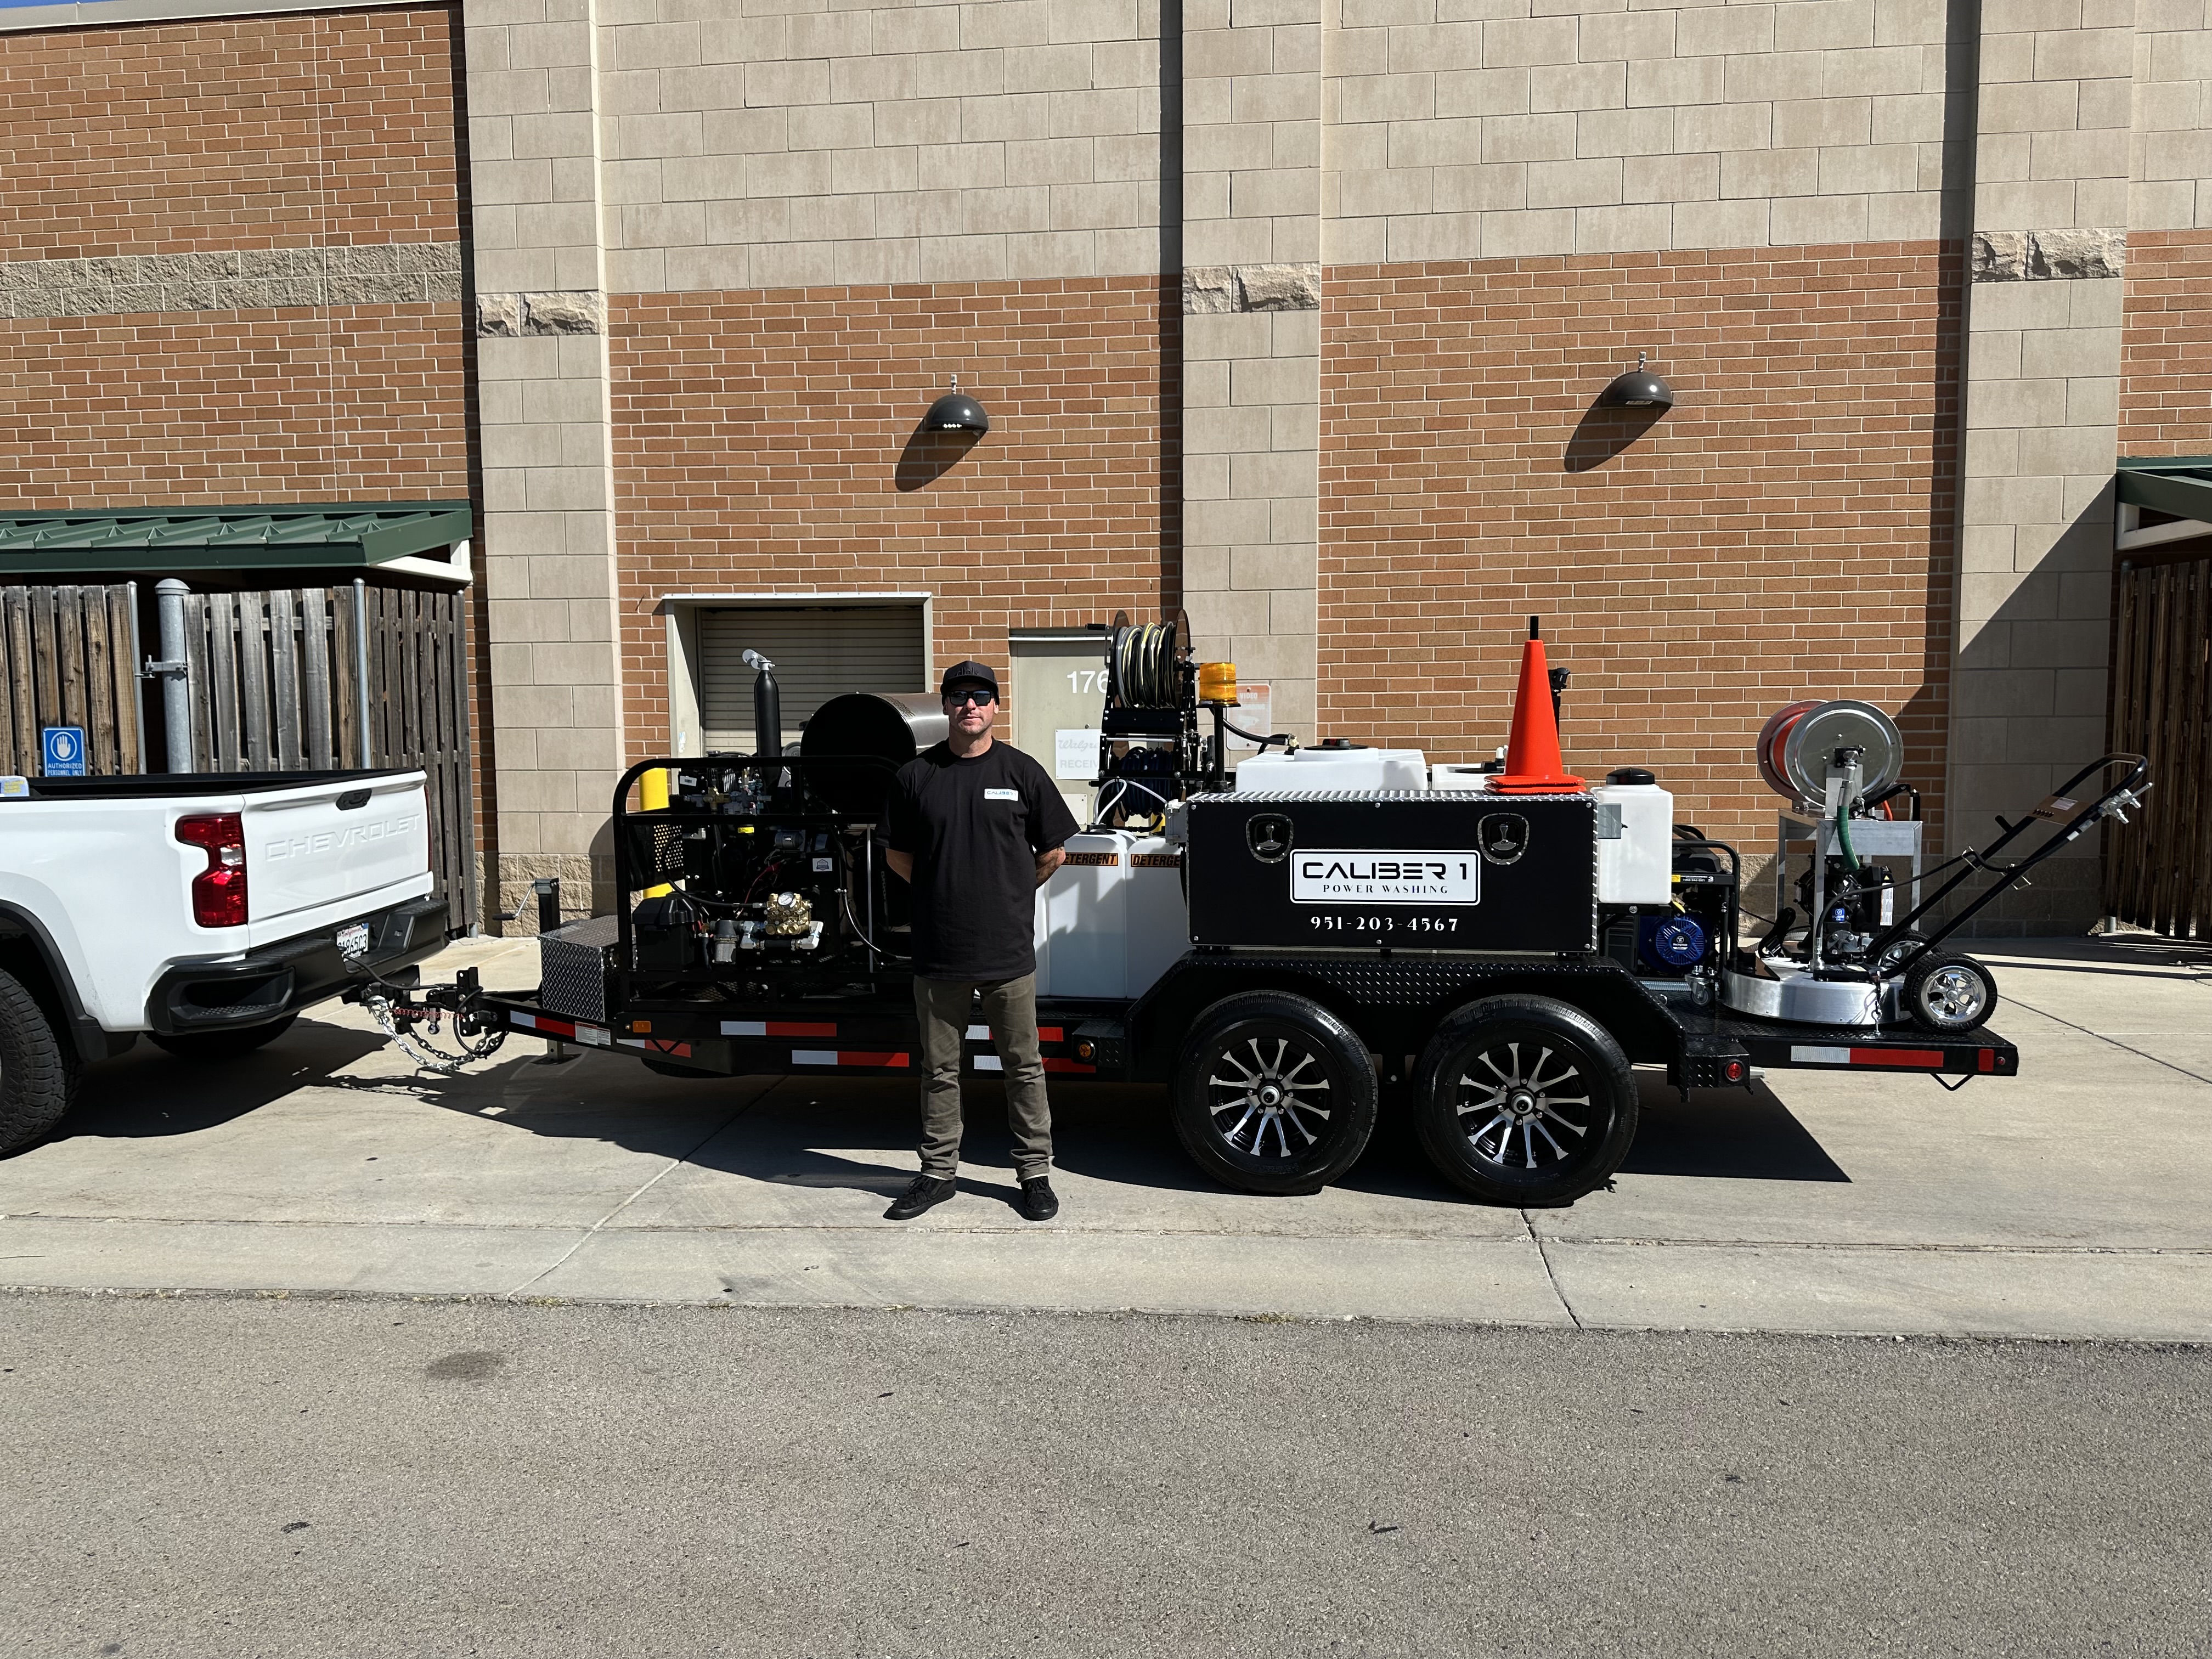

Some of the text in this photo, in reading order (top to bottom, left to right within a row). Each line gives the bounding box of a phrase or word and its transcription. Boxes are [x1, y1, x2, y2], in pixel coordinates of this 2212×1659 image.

[1058, 739, 1098, 752] Walgre
[1060, 759, 1098, 769] RECEIV
[266, 814, 420, 861] CHEVROLET
[1064, 854, 1116, 865] ETERGENT
[1132, 854, 1180, 866] DETERGE
[1302, 862, 1467, 880] CALIBER 1
[1323, 884, 1448, 894] POWER WASHING
[1311, 916, 1458, 932] 951-203-4567
[338, 934, 367, 953] 965C3
